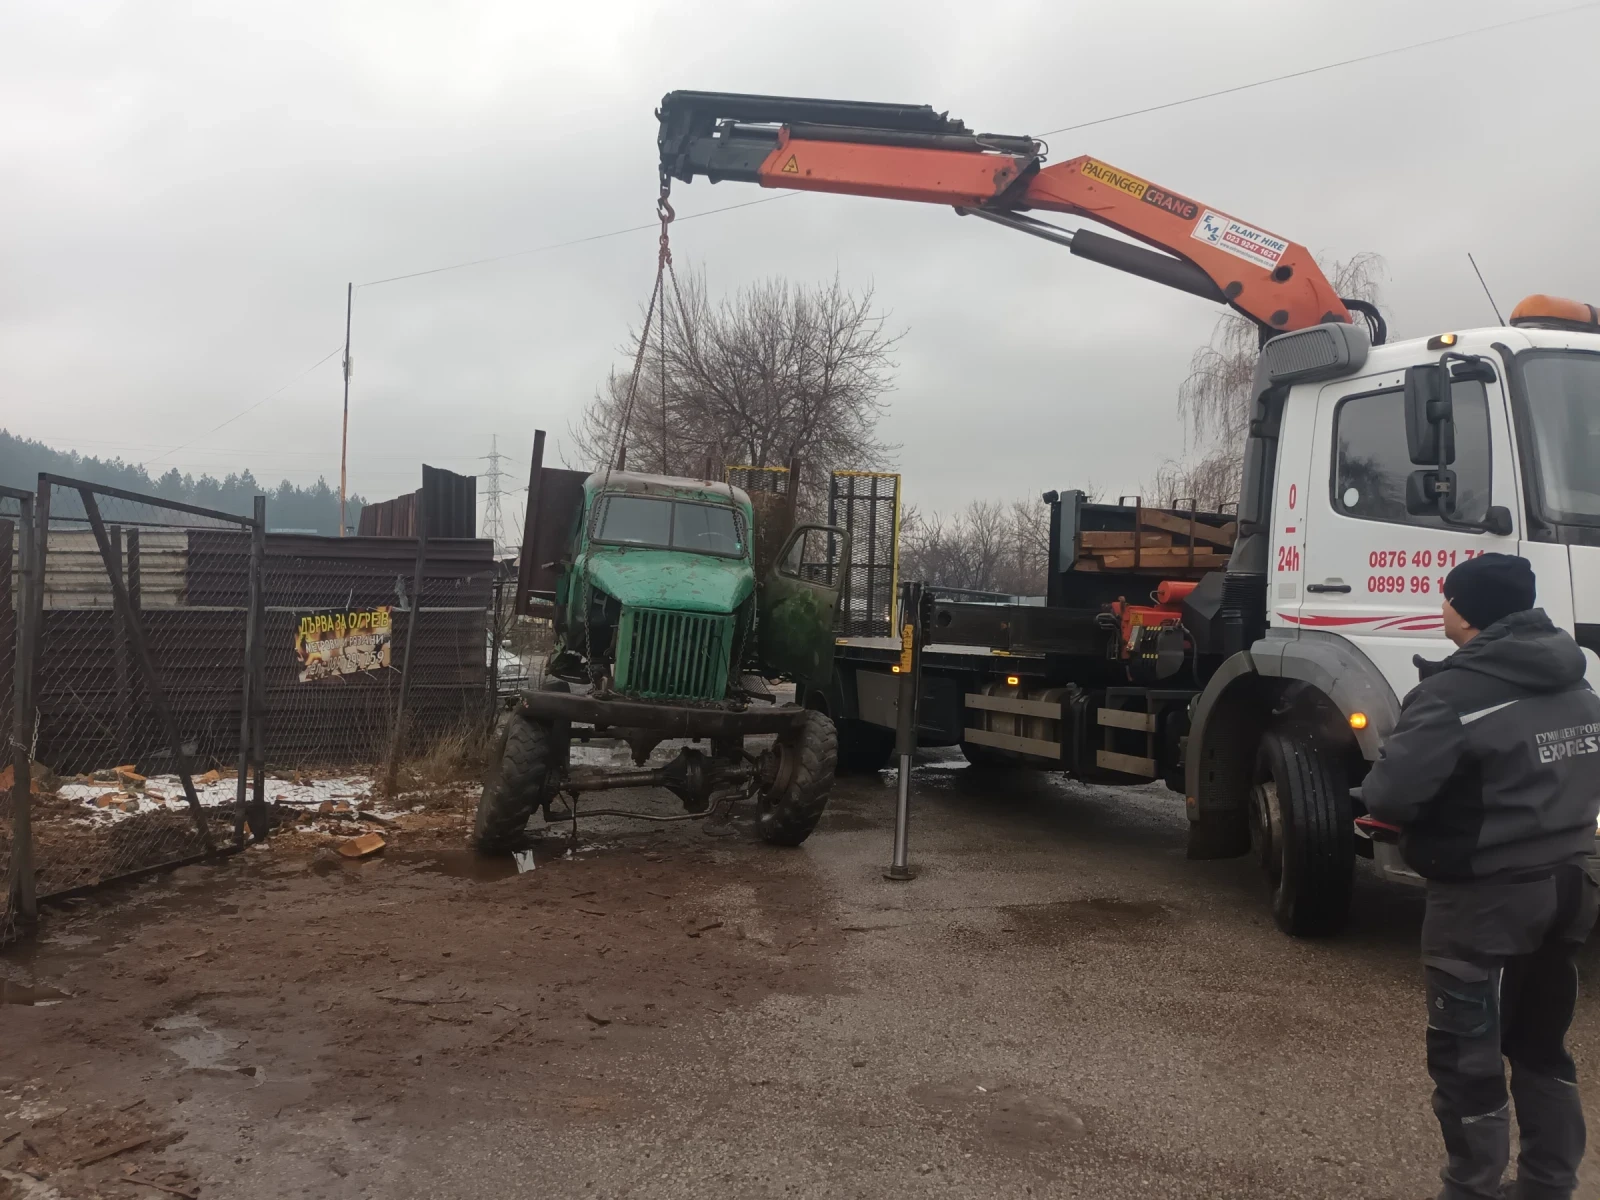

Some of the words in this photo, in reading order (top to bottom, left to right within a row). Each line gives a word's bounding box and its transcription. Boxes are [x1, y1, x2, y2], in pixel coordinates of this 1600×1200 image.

[1082, 162, 1145, 196] PALFINGER
[1145, 189, 1189, 217] CRANE
[1226, 233, 1240, 244] 023
[1241, 240, 1259, 252] 9247
[1260, 248, 1277, 260] 1621
[1229, 224, 1261, 241] PLANT
[1260, 237, 1285, 252] HIRE
[1289, 484, 1296, 509] 0
[1278, 546, 1299, 571] 24h
[1369, 550, 1406, 567] 0876
[1412, 550, 1432, 567] 40
[1437, 549, 1456, 567] 91
[1367, 575, 1405, 593] 0899
[1410, 575, 1430, 593] 96
[301, 614, 334, 635] ДЪРВА
[335, 613, 346, 630] ЗА
[348, 611, 389, 629] ОГРЕВ
[1535, 722, 1600, 744] ГУМИЦЕНТРОВ
[1538, 736, 1600, 763] EXPRES
